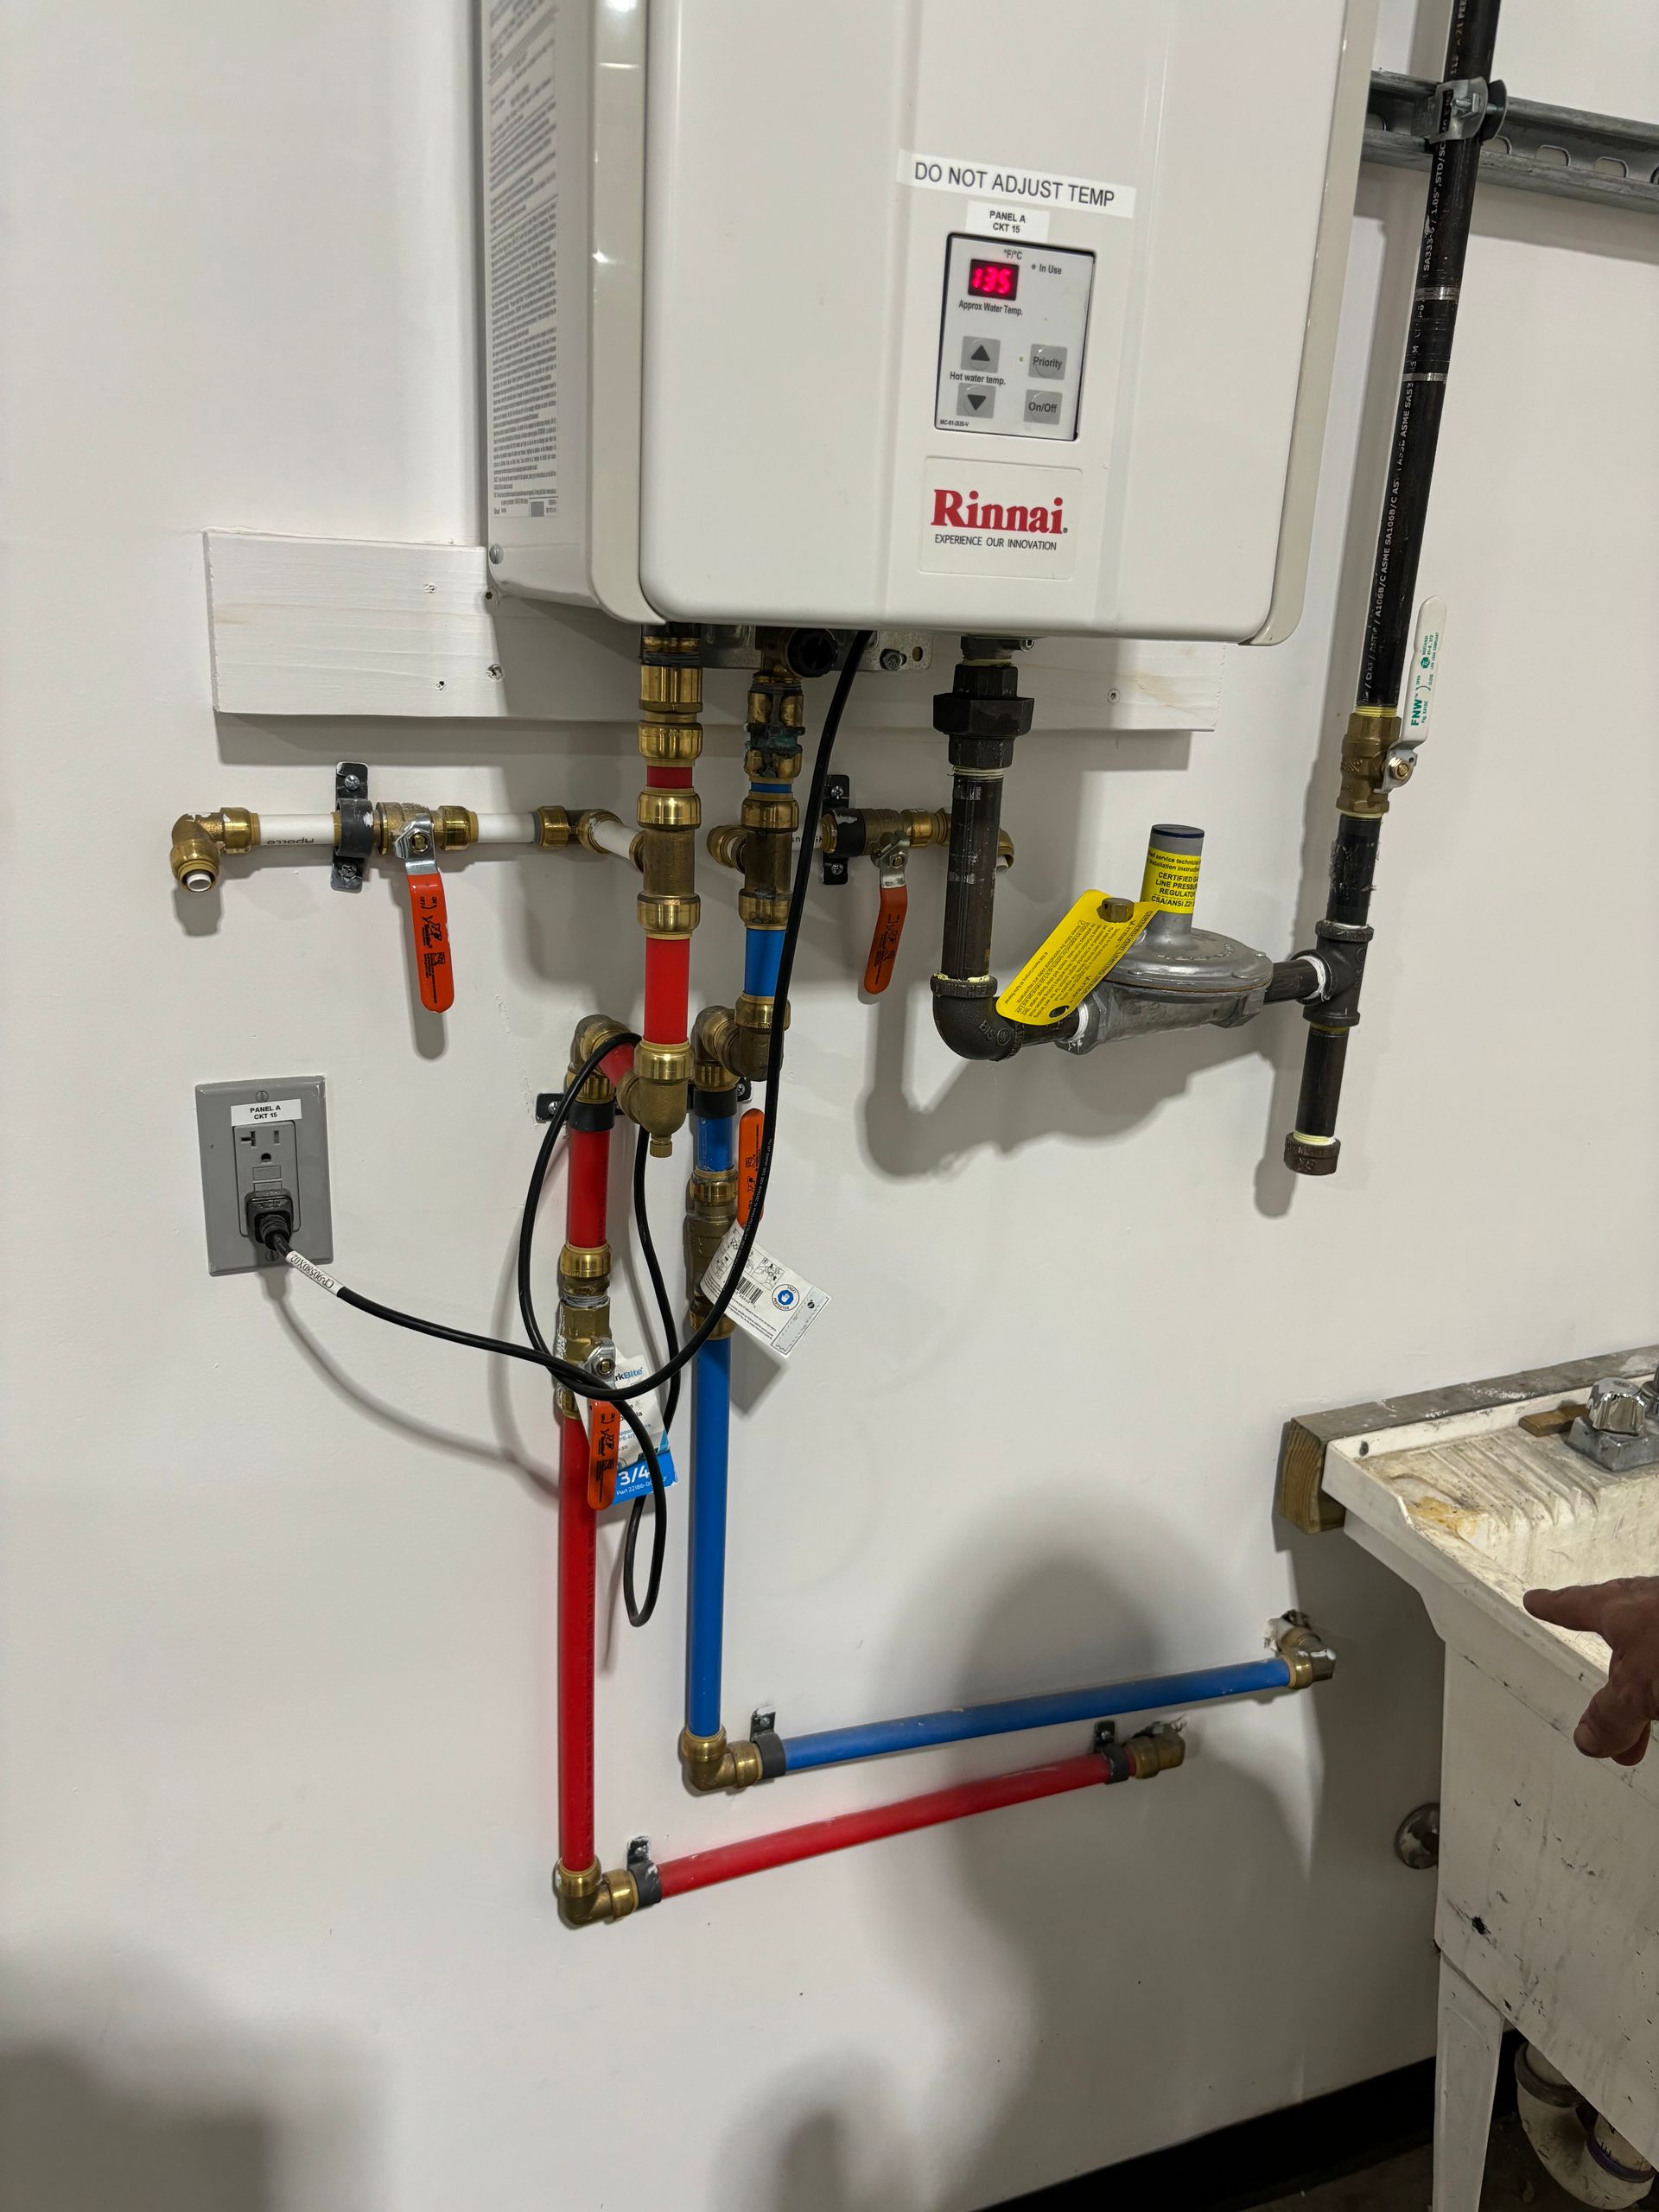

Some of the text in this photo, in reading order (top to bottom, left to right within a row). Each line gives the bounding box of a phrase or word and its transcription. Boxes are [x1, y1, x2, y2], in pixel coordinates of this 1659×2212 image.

[915, 162, 1115, 207] DO NOT ADJUST TEMP
[989, 210, 1026, 223] PANEL A
[993, 222, 1020, 233] CKT 15
[1039, 264, 1062, 275] In Use
[971, 265, 1012, 295] 135
[958, 300, 1023, 316] Approx Water Temp.
[1033, 356, 1062, 370] Priority
[950, 371, 1006, 386] Hot water temp.
[1028, 401, 1057, 414] On/Off
[1401, 410, 1410, 437] ASME
[935, 534, 1057, 551] EXPERIENCE OUR INNOVATION
[1156, 854, 1175, 863] service
[1156, 879, 1171, 887] LINE
[1158, 872, 1192, 881] CERTIFIED
[1151, 895, 1183, 907] CSA/ANSI
[617, 1485, 628, 1495] Part
